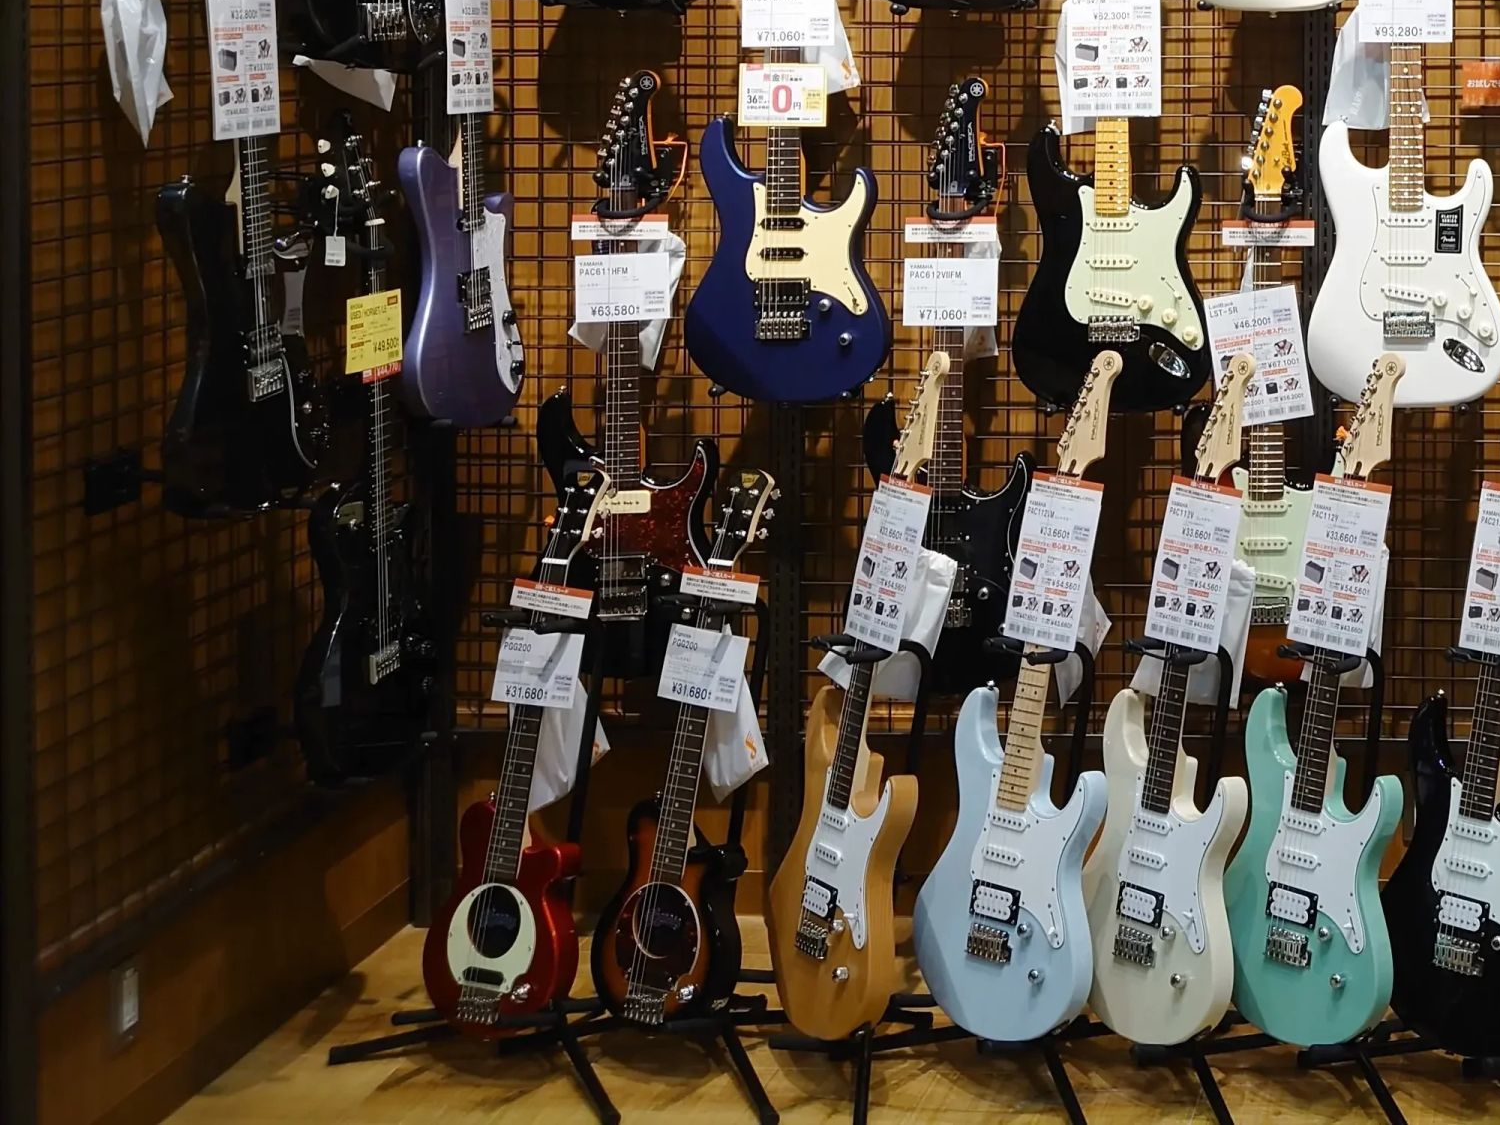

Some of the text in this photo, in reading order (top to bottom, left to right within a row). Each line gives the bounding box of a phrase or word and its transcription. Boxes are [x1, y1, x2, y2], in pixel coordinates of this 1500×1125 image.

[757, 31, 802, 43] ¥71,060
[1374, 27, 1418, 38] ¥93,280
[772, 85, 793, 113] 0
[579, 267, 629, 277] PAC611HFM
[590, 305, 636, 317] ¥63,580
[919, 309, 963, 321] ¥71,060
[1234, 316, 1269, 329] ¥46,200
